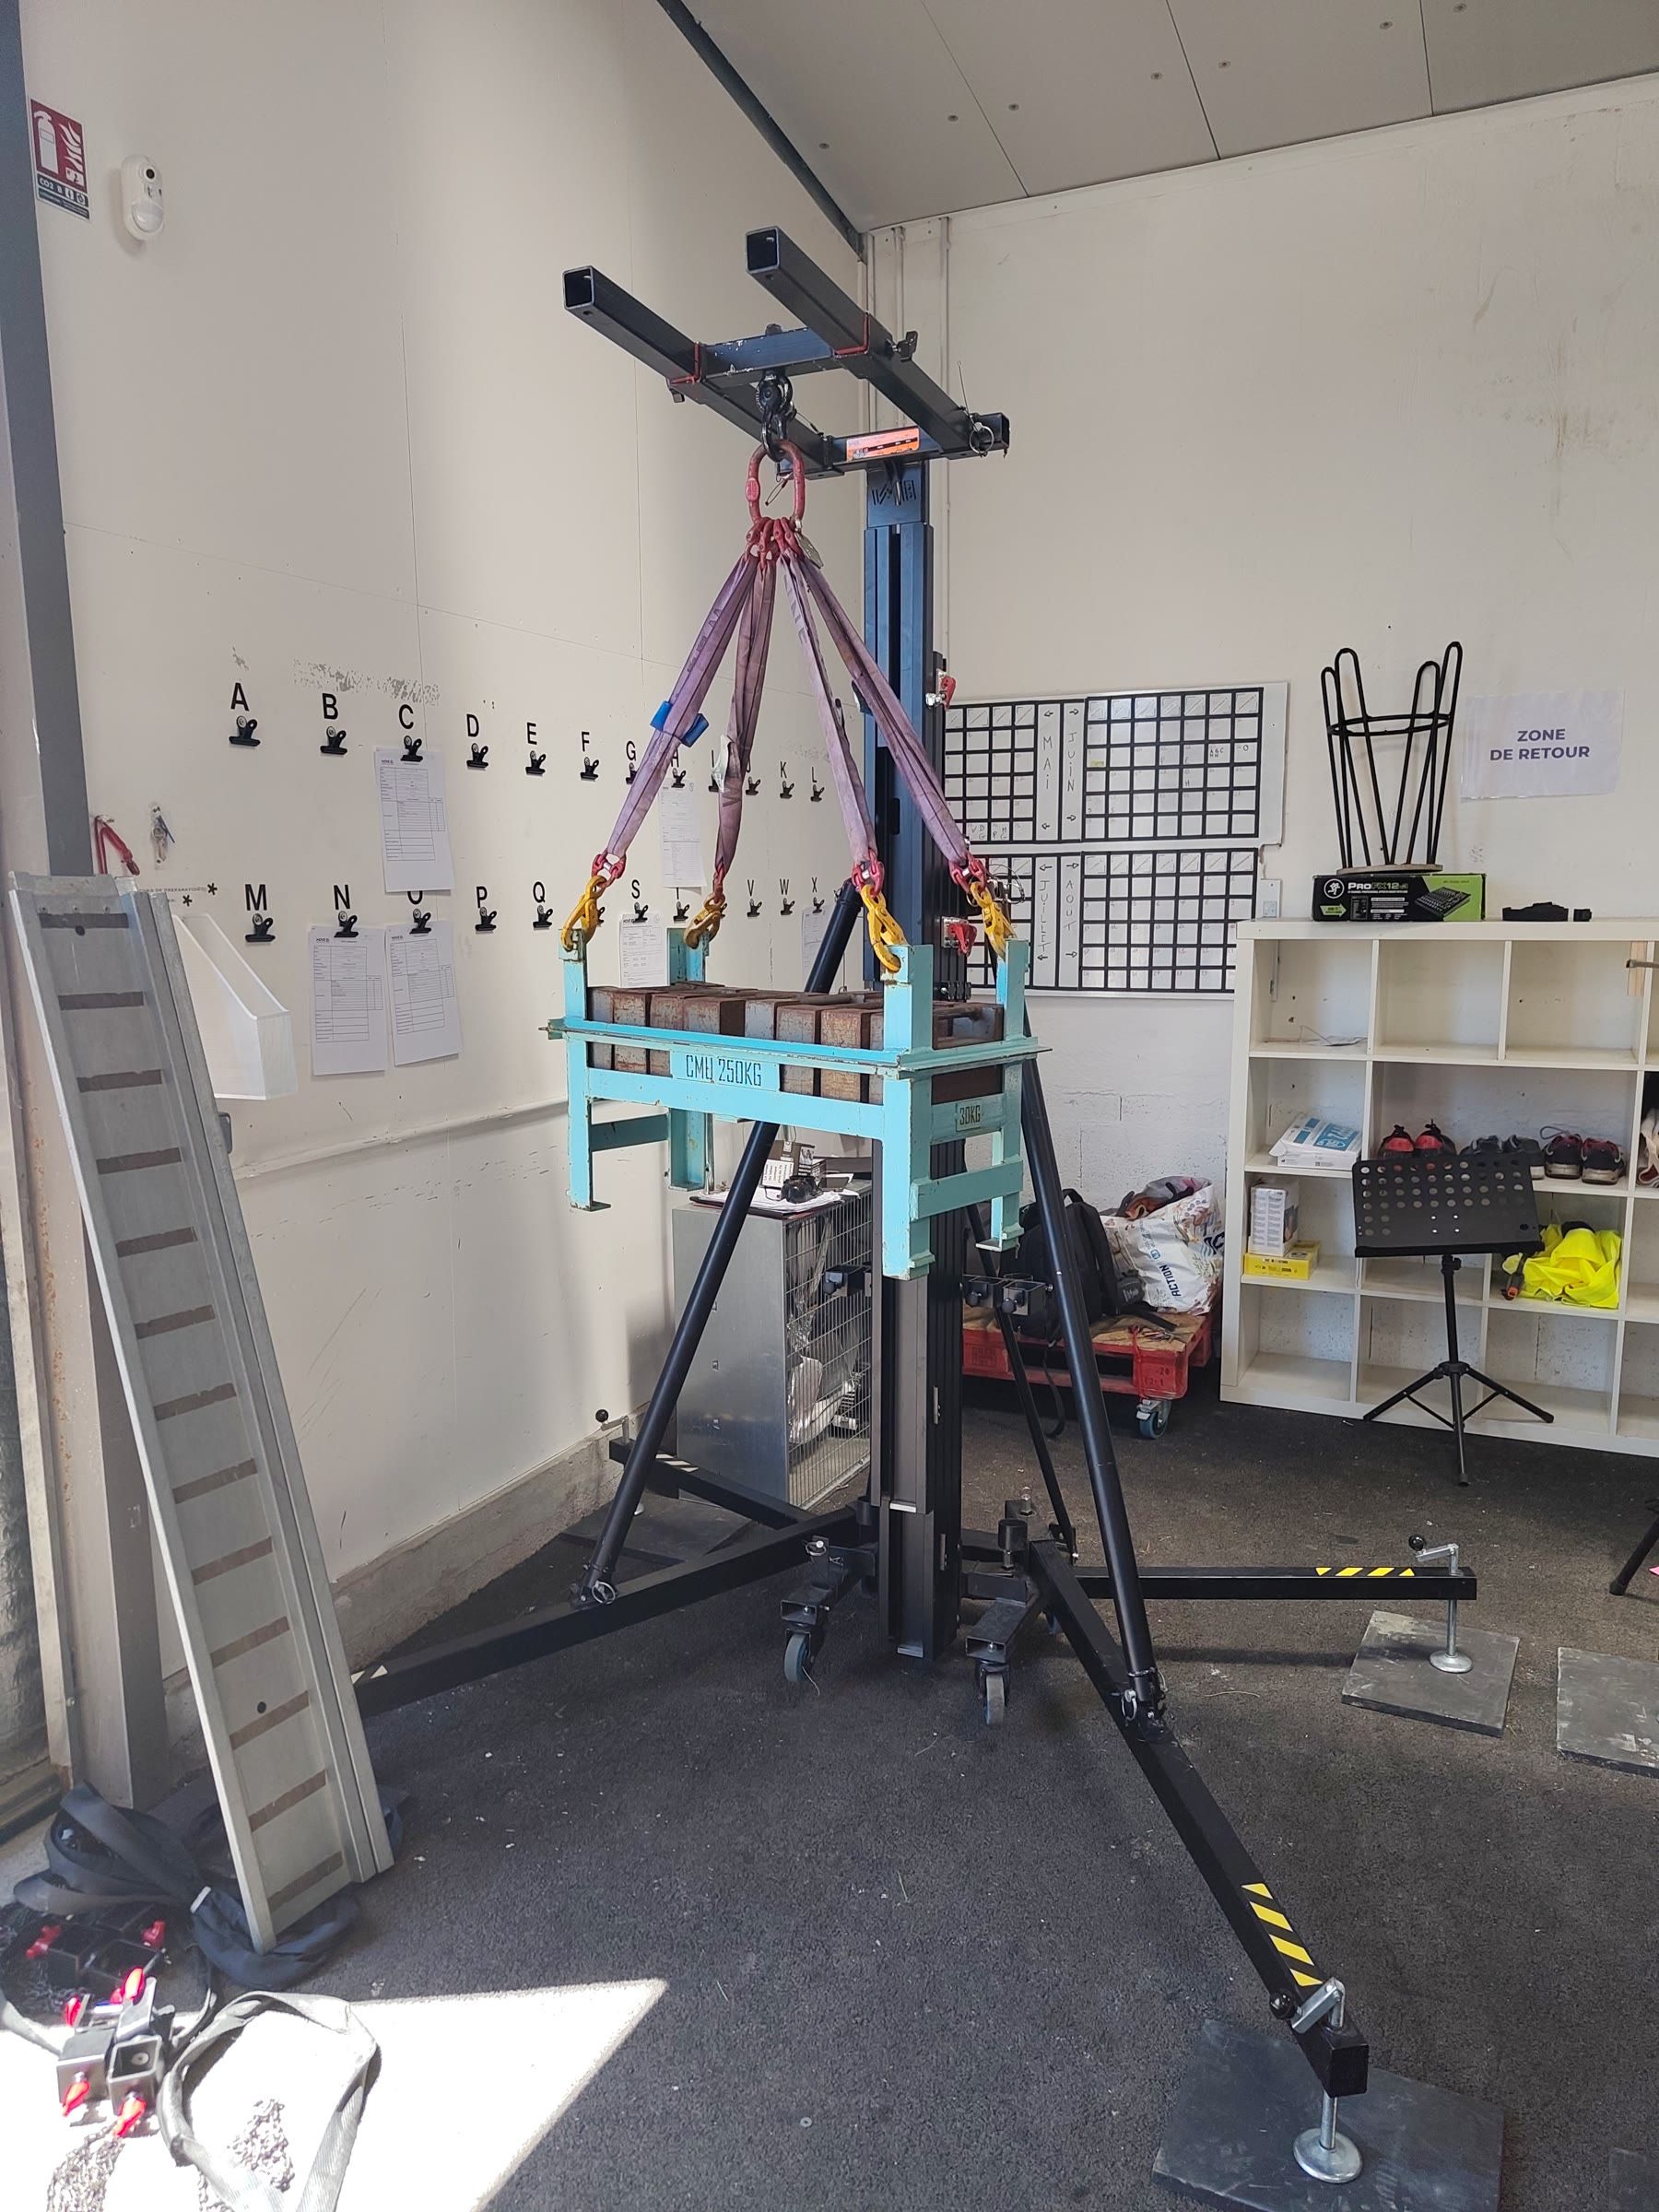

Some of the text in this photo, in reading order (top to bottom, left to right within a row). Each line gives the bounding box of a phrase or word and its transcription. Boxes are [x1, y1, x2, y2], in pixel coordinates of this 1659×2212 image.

[231, 682, 249, 712] A
[322, 692, 339, 721] B
[398, 704, 415, 730] C
[466, 713, 480, 737] D
[526, 723, 537, 745] E
[581, 731, 590, 752] F
[626, 740, 637, 761] G
[780, 760, 788, 779] K
[811, 766, 818, 783] L
[1517, 728, 1566, 742] ZONE
[1489, 746, 1590, 761] DE RETOUR
[244, 884, 267, 911] M
[333, 884, 351, 910] N
[476, 886, 488, 908] P
[533, 881, 546, 903] Q
[631, 879, 641, 900] S
[747, 879, 755, 897] V
[779, 878, 790, 896] W
[811, 877, 818, 893] X
[718, 1058, 762, 1087] 250KG
[959, 1104, 981, 1125] 30KG
[1159, 1264, 1182, 1297] ACTION
